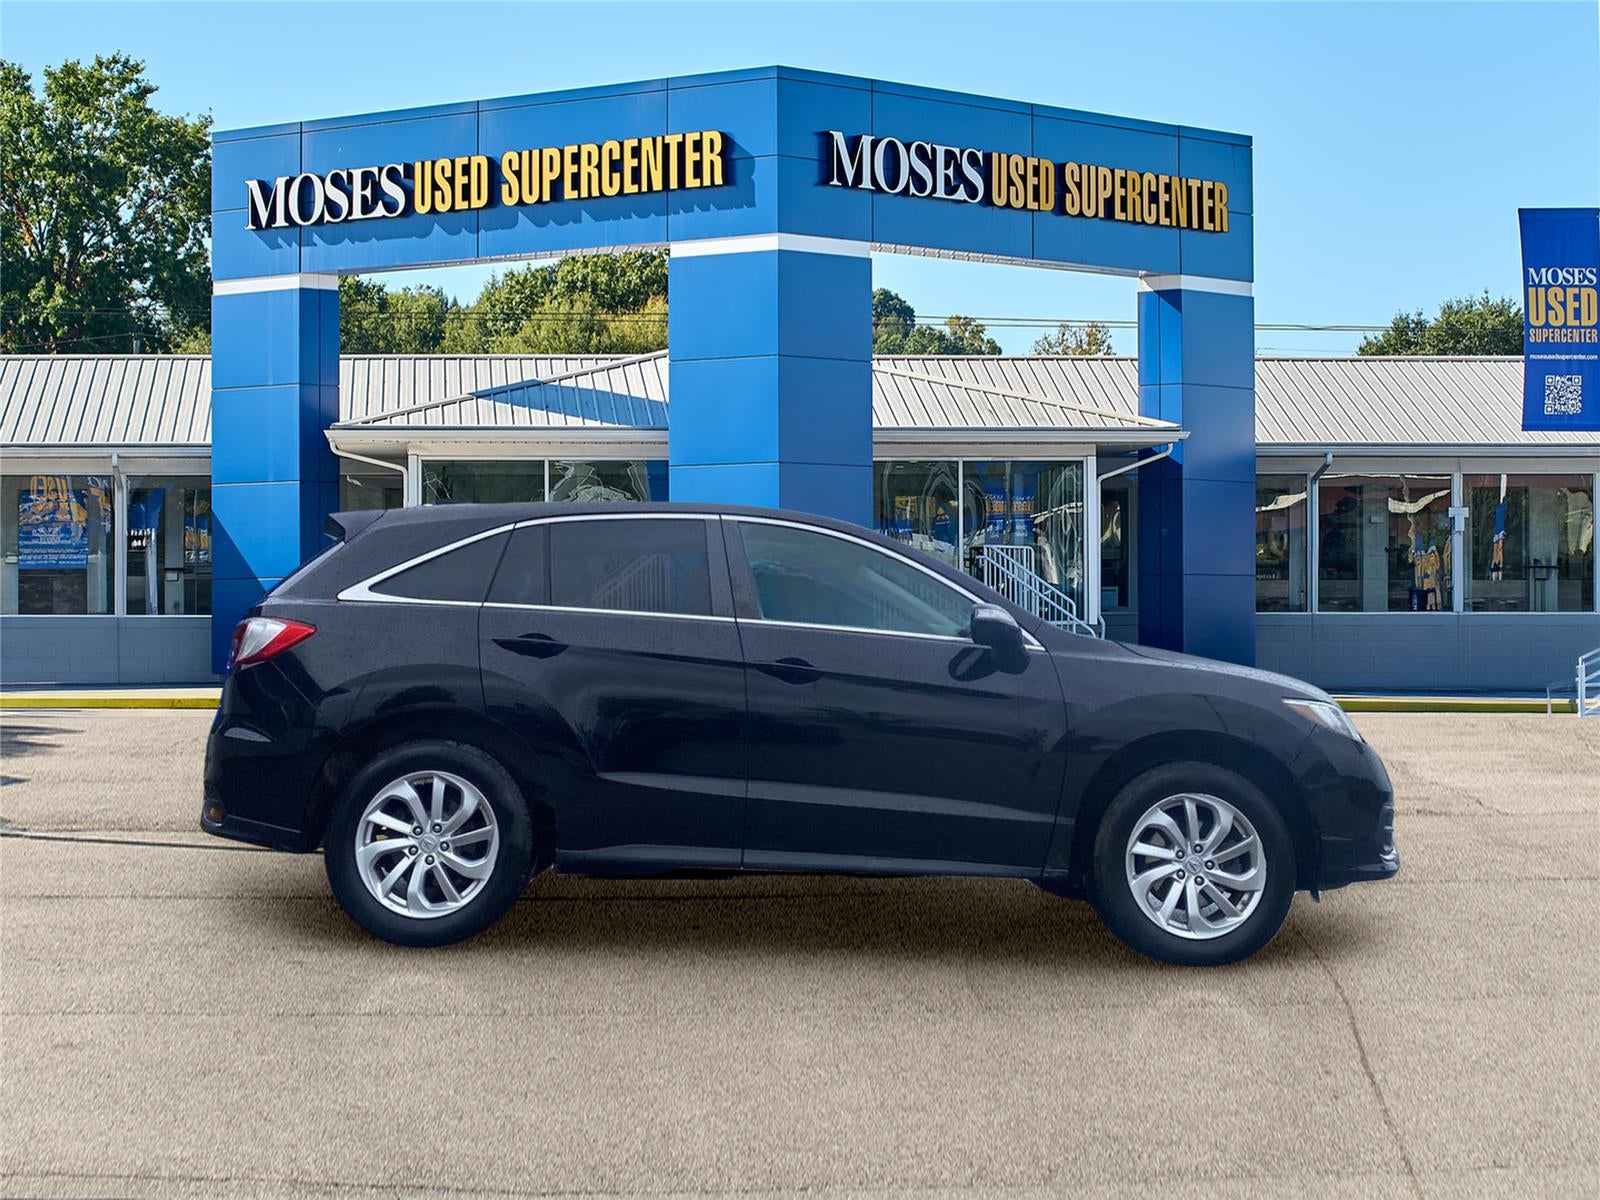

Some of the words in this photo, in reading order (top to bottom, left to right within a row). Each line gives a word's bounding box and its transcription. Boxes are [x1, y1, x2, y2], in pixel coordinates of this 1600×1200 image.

[244, 162, 410, 231] MOSES
[413, 156, 489, 215] USED
[501, 130, 724, 206] SUPERCENTER
[828, 130, 985, 203] MOSES
[991, 151, 1055, 211] USED
[1065, 160, 1229, 233] SUPERCENTER
[1527, 267, 1597, 286] MOSES
[1528, 286, 1598, 327] USED
[1529, 328, 1598, 343] SUPERCENTER
[1529, 353, 1598, 361] mosesusedsupercenter.com
